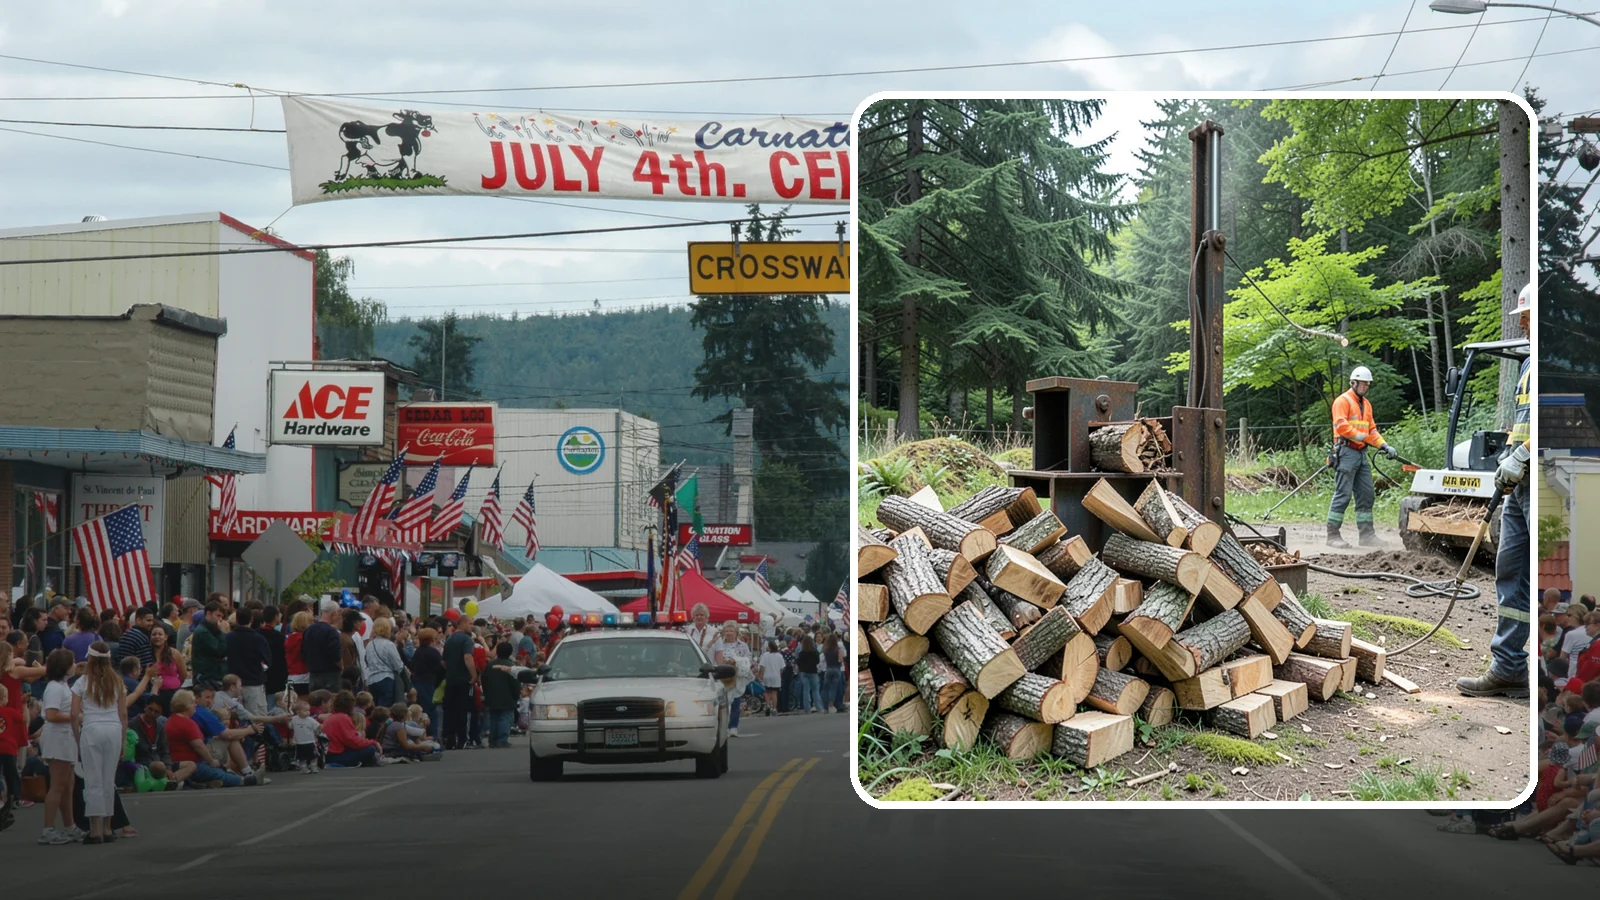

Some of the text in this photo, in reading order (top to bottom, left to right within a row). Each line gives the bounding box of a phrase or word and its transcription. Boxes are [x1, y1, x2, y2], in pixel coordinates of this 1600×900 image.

[481, 141, 604, 192] JULY
[632, 150, 746, 197] 4th.
[697, 254, 850, 280] CROSSWA
[283, 380, 373, 420] ACE
[405, 409, 452, 422] CEDAR
[283, 421, 371, 436] Hardware
[416, 428, 477, 447] Coca-Cola
[83, 484, 155, 495] St. Vincent de Paul
[688, 526, 741, 535] CRNATION
[699, 535, 730, 543] GLASS
